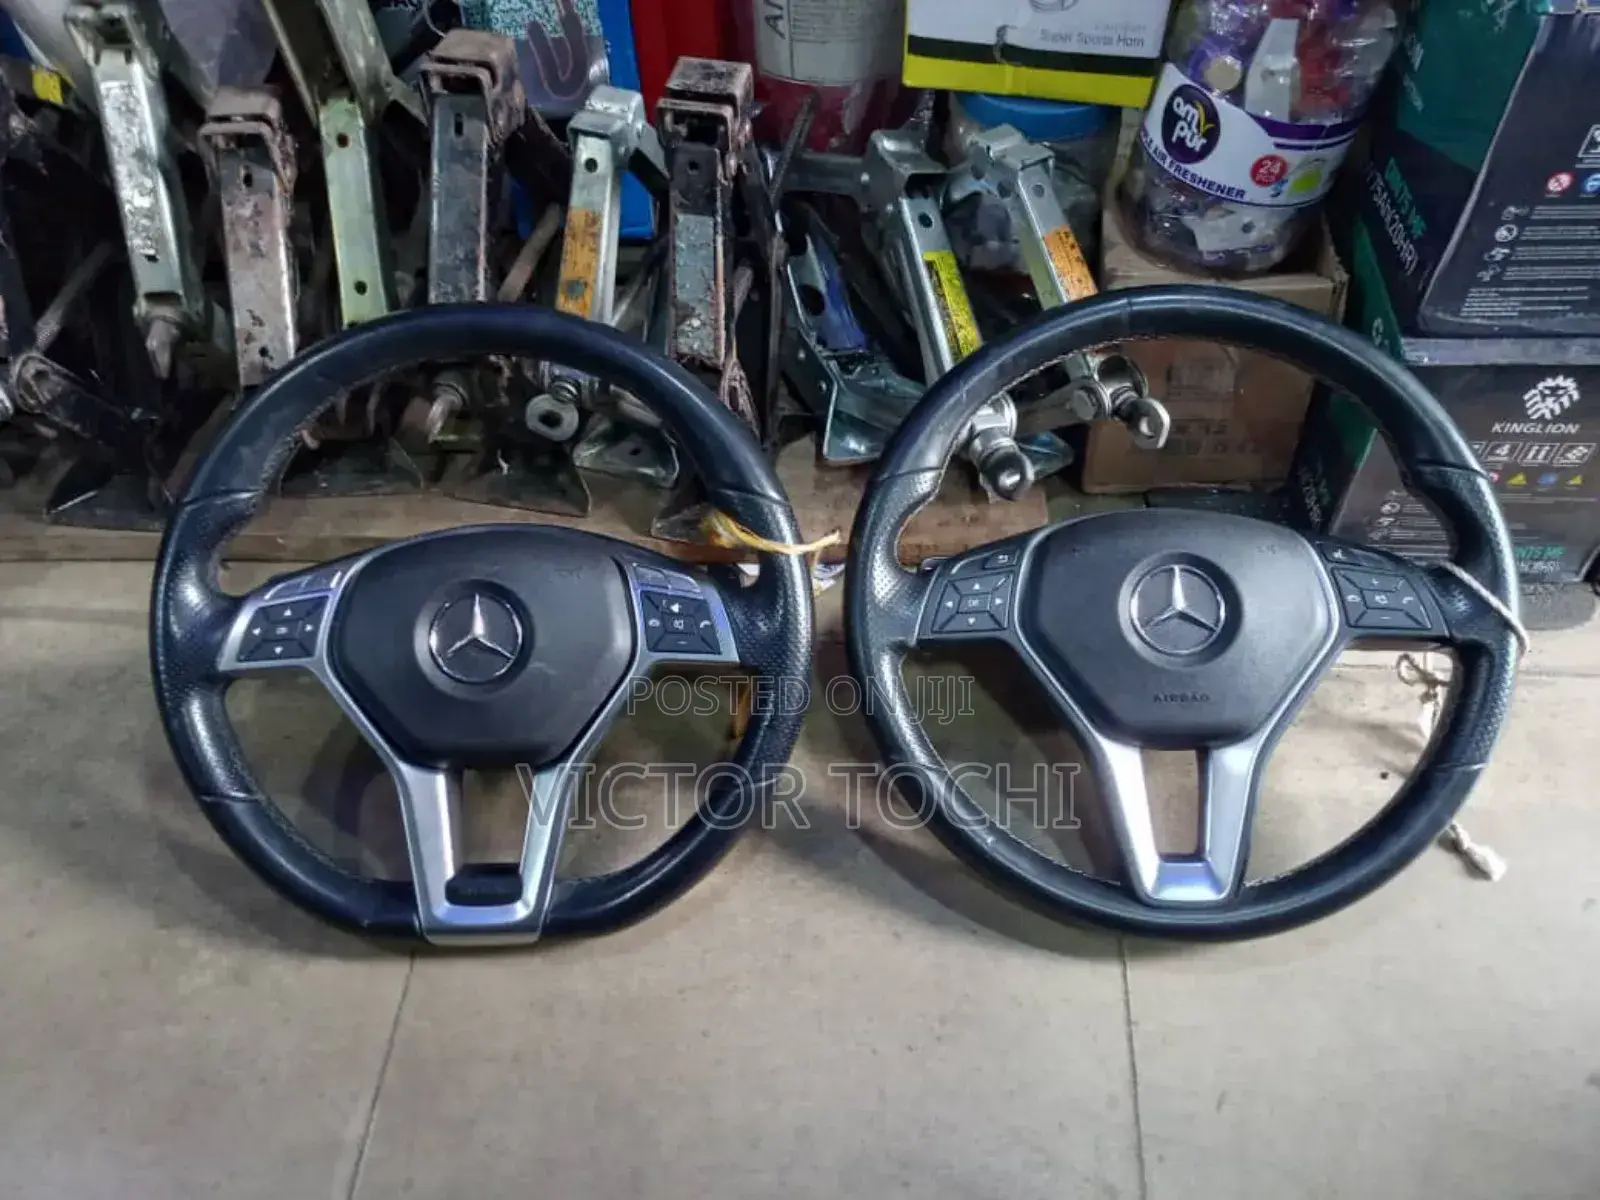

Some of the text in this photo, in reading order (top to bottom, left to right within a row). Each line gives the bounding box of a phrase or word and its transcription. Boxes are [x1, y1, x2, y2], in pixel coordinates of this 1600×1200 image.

[1259, 159, 1281, 174] 24
[1168, 159, 1246, 200] FRESHENER
[1491, 422, 1580, 434] KINGLION
